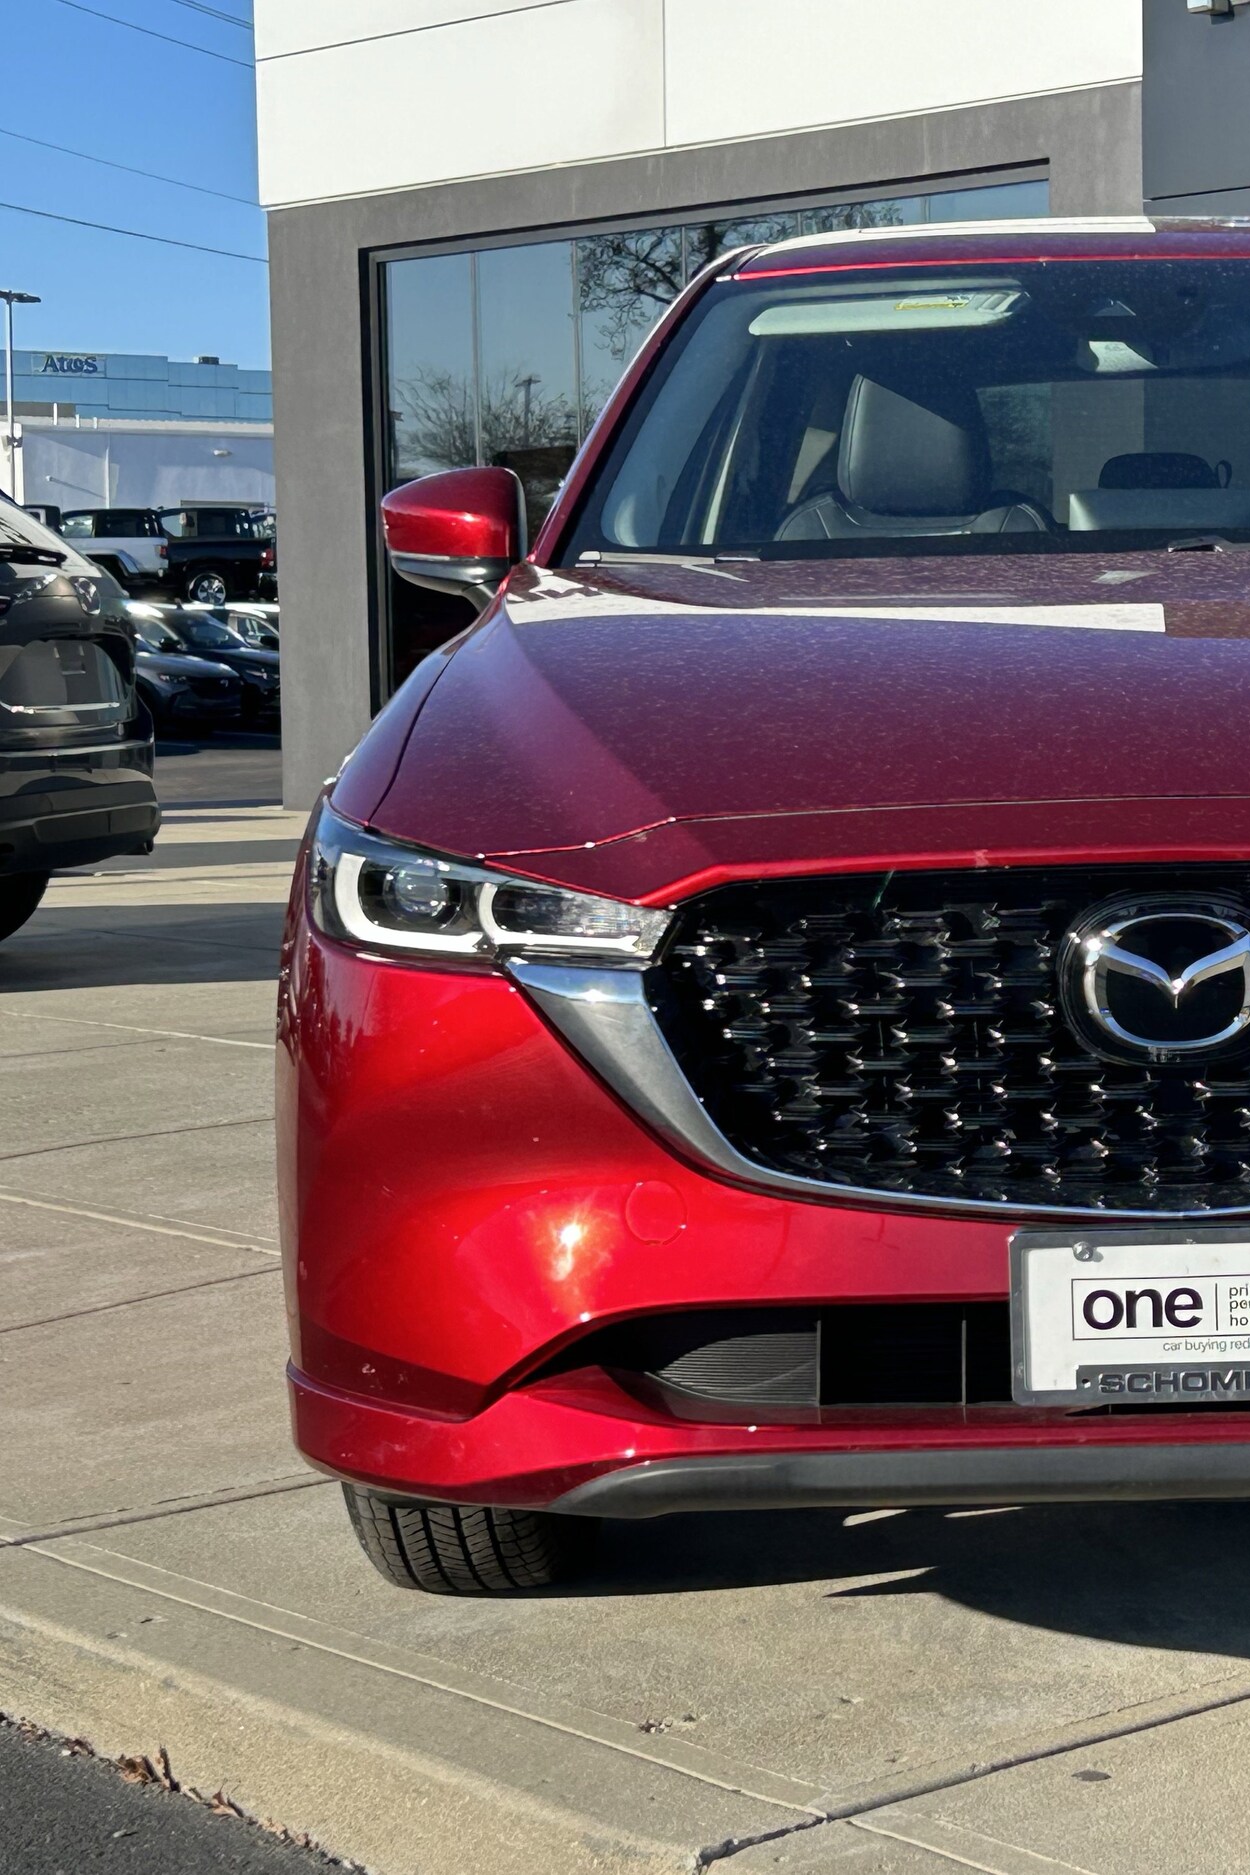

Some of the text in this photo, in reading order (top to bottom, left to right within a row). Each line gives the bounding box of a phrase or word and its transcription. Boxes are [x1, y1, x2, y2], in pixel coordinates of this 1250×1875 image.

[1082, 1287, 1204, 1331] one
[1162, 1341, 1182, 1351] car
[1185, 1339, 1227, 1352] buying
